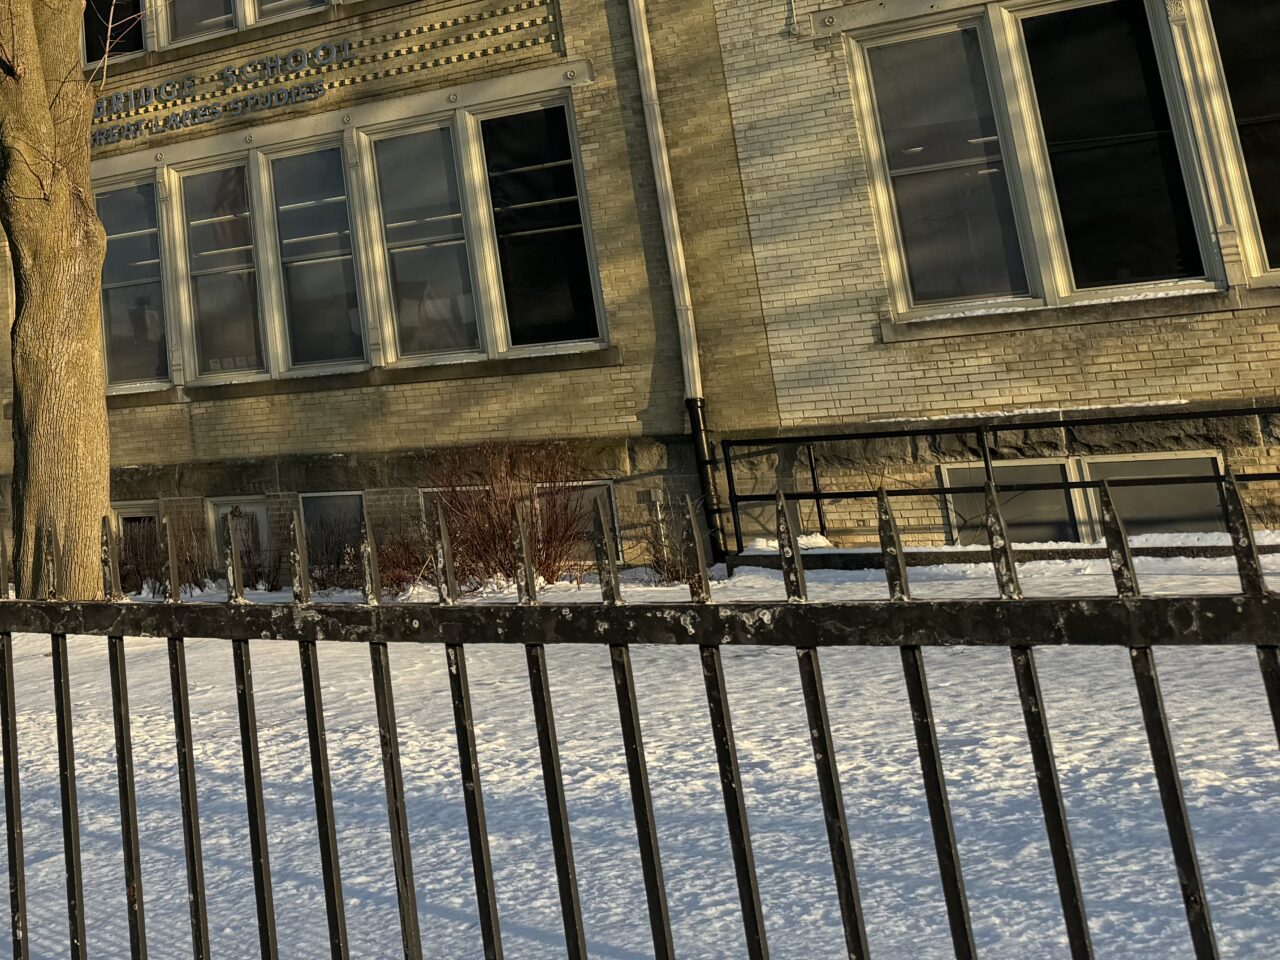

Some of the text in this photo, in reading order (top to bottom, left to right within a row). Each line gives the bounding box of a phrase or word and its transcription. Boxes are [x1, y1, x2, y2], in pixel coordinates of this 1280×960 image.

[223, 39, 354, 87] SCHOOL
[152, 102, 223, 133] LAKES
[230, 80, 325, 116] STUDIES
